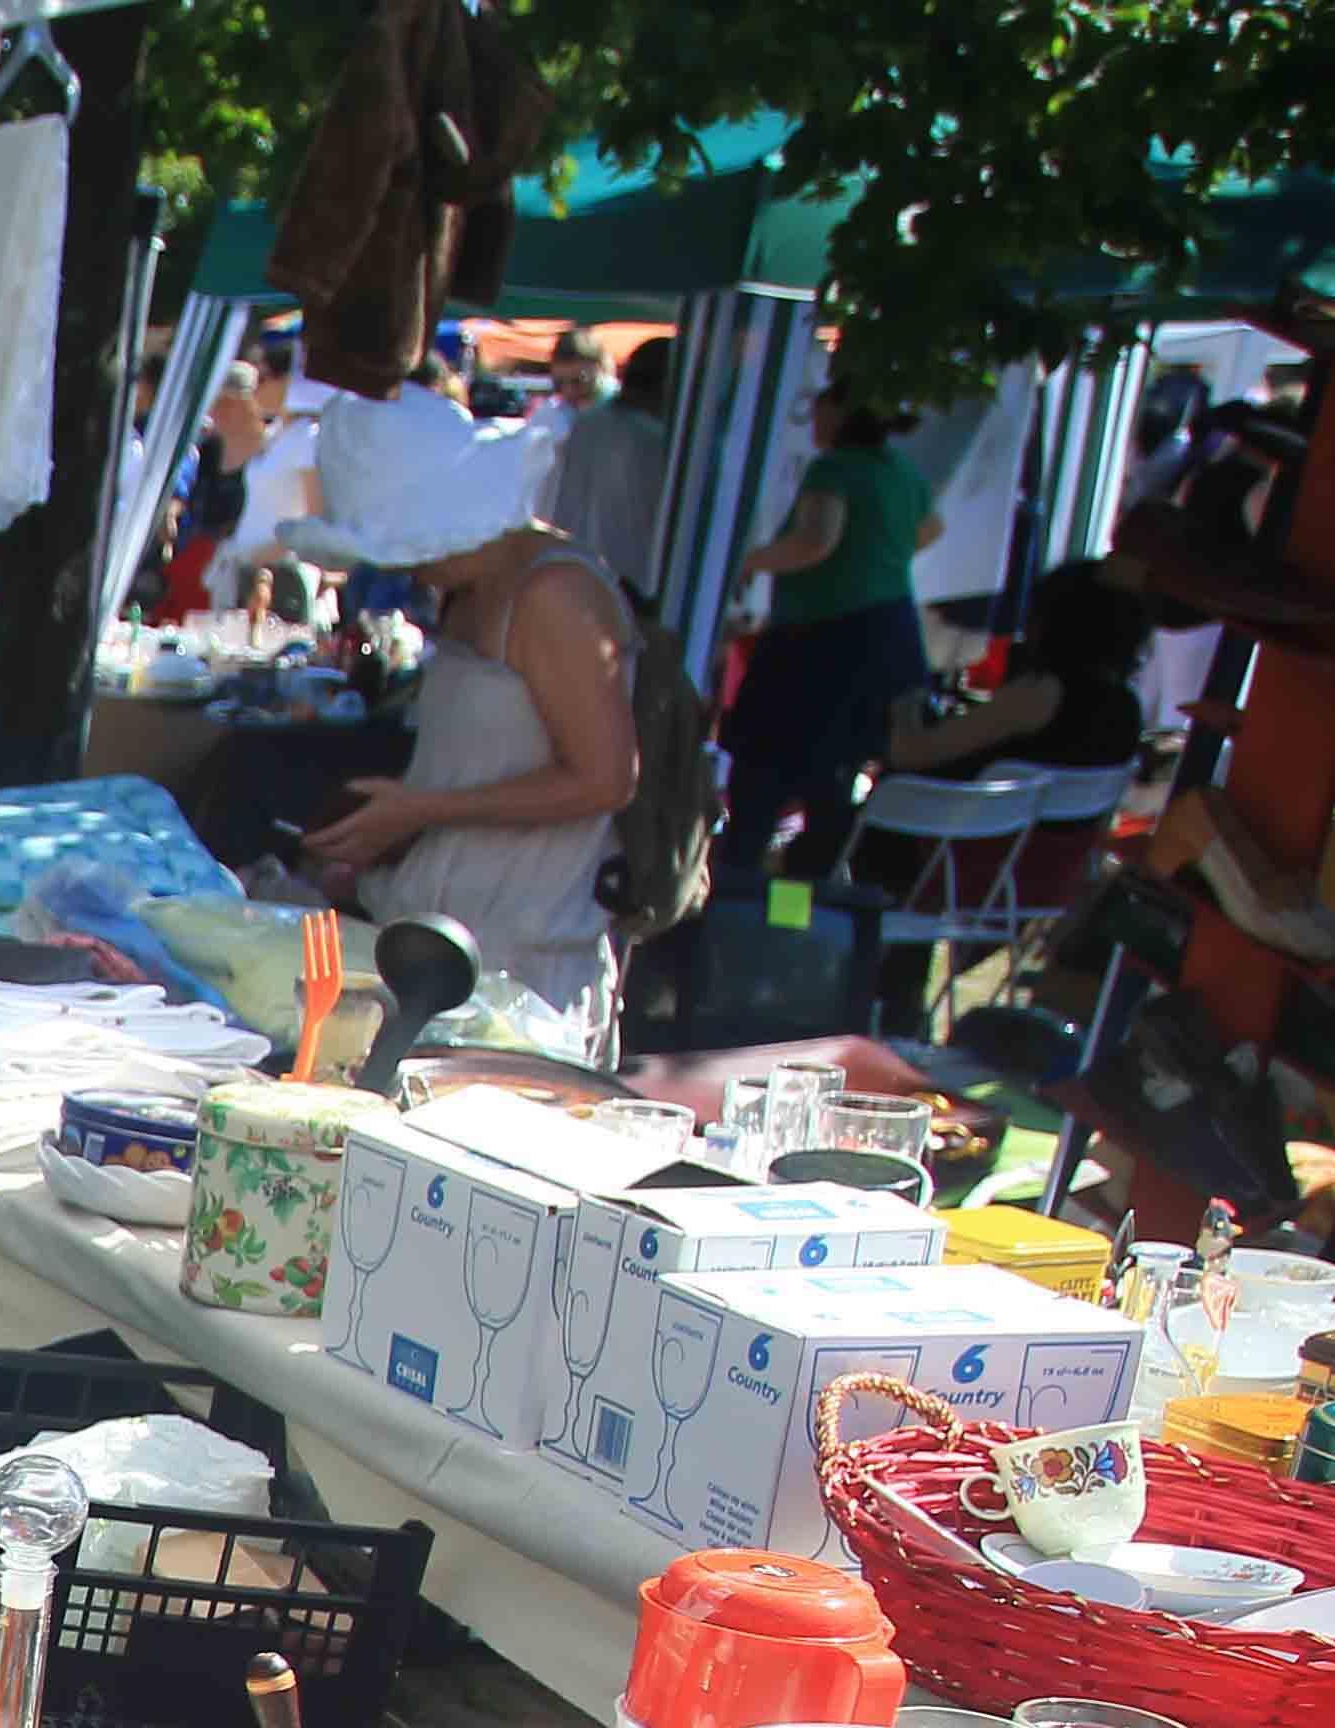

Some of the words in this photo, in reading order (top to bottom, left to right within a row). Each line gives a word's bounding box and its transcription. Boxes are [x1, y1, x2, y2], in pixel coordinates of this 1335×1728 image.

[427, 1173, 448, 1209] 6
[410, 1206, 455, 1239] Country
[639, 1226, 662, 1260] 6
[798, 1232, 829, 1268] 6
[622, 1257, 660, 1284] Count
[748, 1332, 774, 1371] 6
[951, 1343, 993, 1385] 6
[727, 1365, 782, 1405] Country
